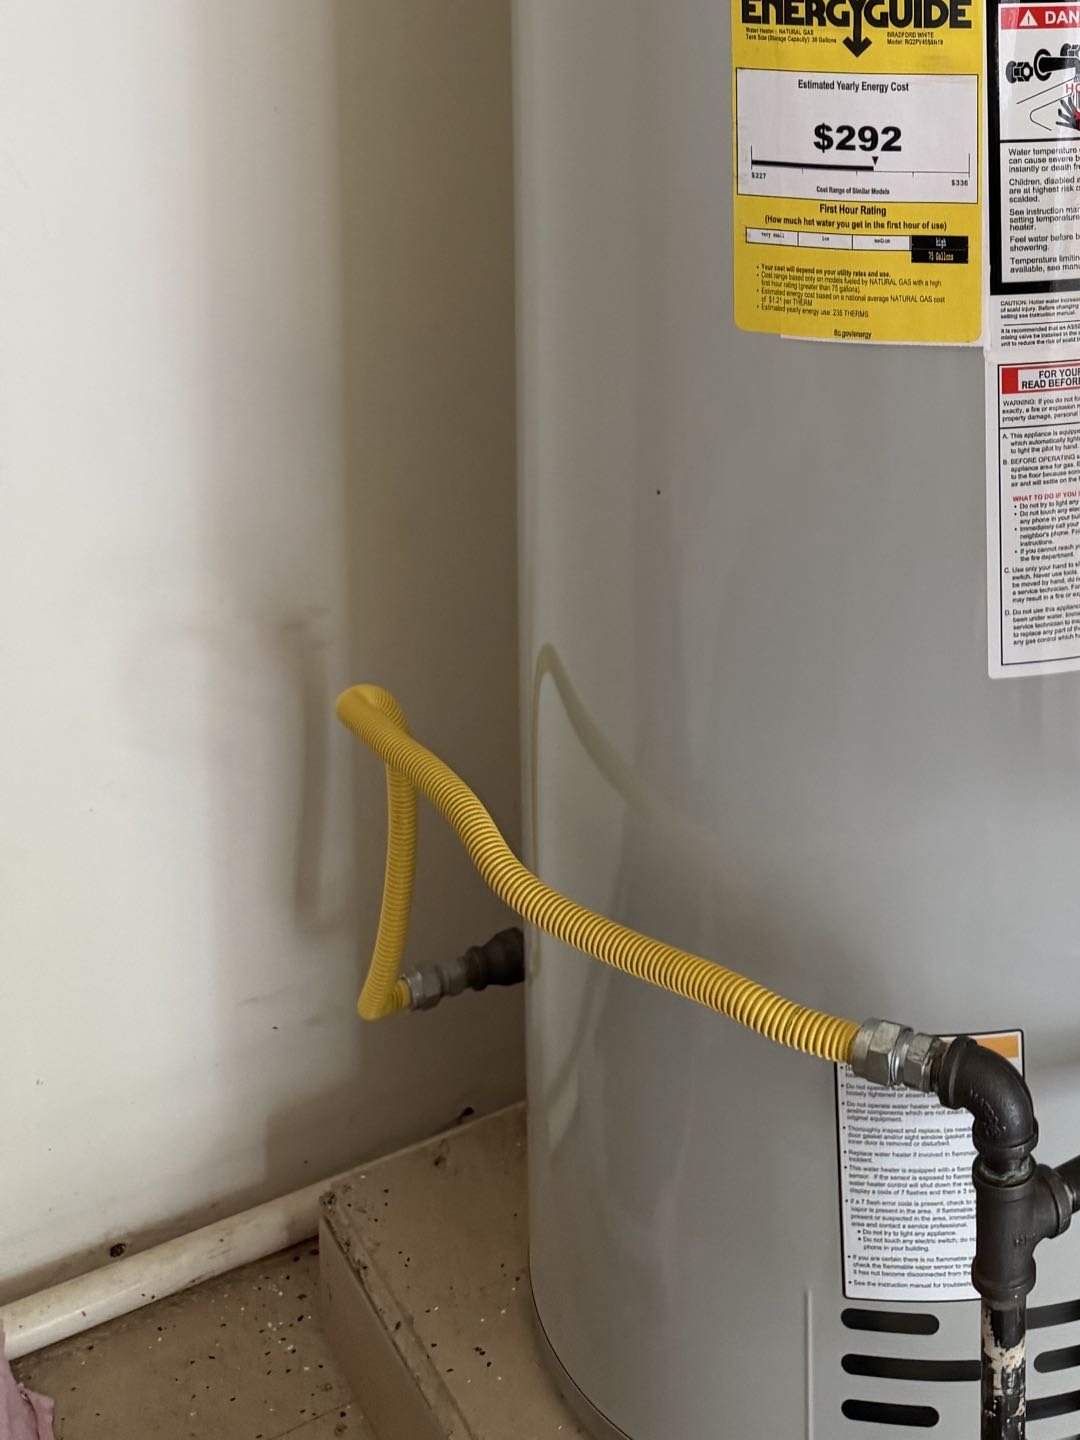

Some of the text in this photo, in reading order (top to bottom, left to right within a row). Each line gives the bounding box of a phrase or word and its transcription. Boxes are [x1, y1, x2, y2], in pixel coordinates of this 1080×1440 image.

[798, 79, 910, 94] Estimated Yearly Energy Cost
[813, 122, 902, 153] $292
[1008, 148, 1031, 156] Water
[1032, 146, 1077, 156] temperature
[1008, 157, 1023, 165] can
[1024, 156, 1047, 164] cause
[1048, 155, 1074, 164] severe
[1008, 164, 1040, 174] instantly
[1050, 164, 1072, 172] death
[816, 185, 890, 195] Cost Range of Similar Models
[819, 203, 887, 217] First Hour Rating
[764, 215, 948, 231] (How much hot water you get in the first hour of use)
[1038, 369, 1057, 380] FOR
[1021, 379, 1046, 390] READ
